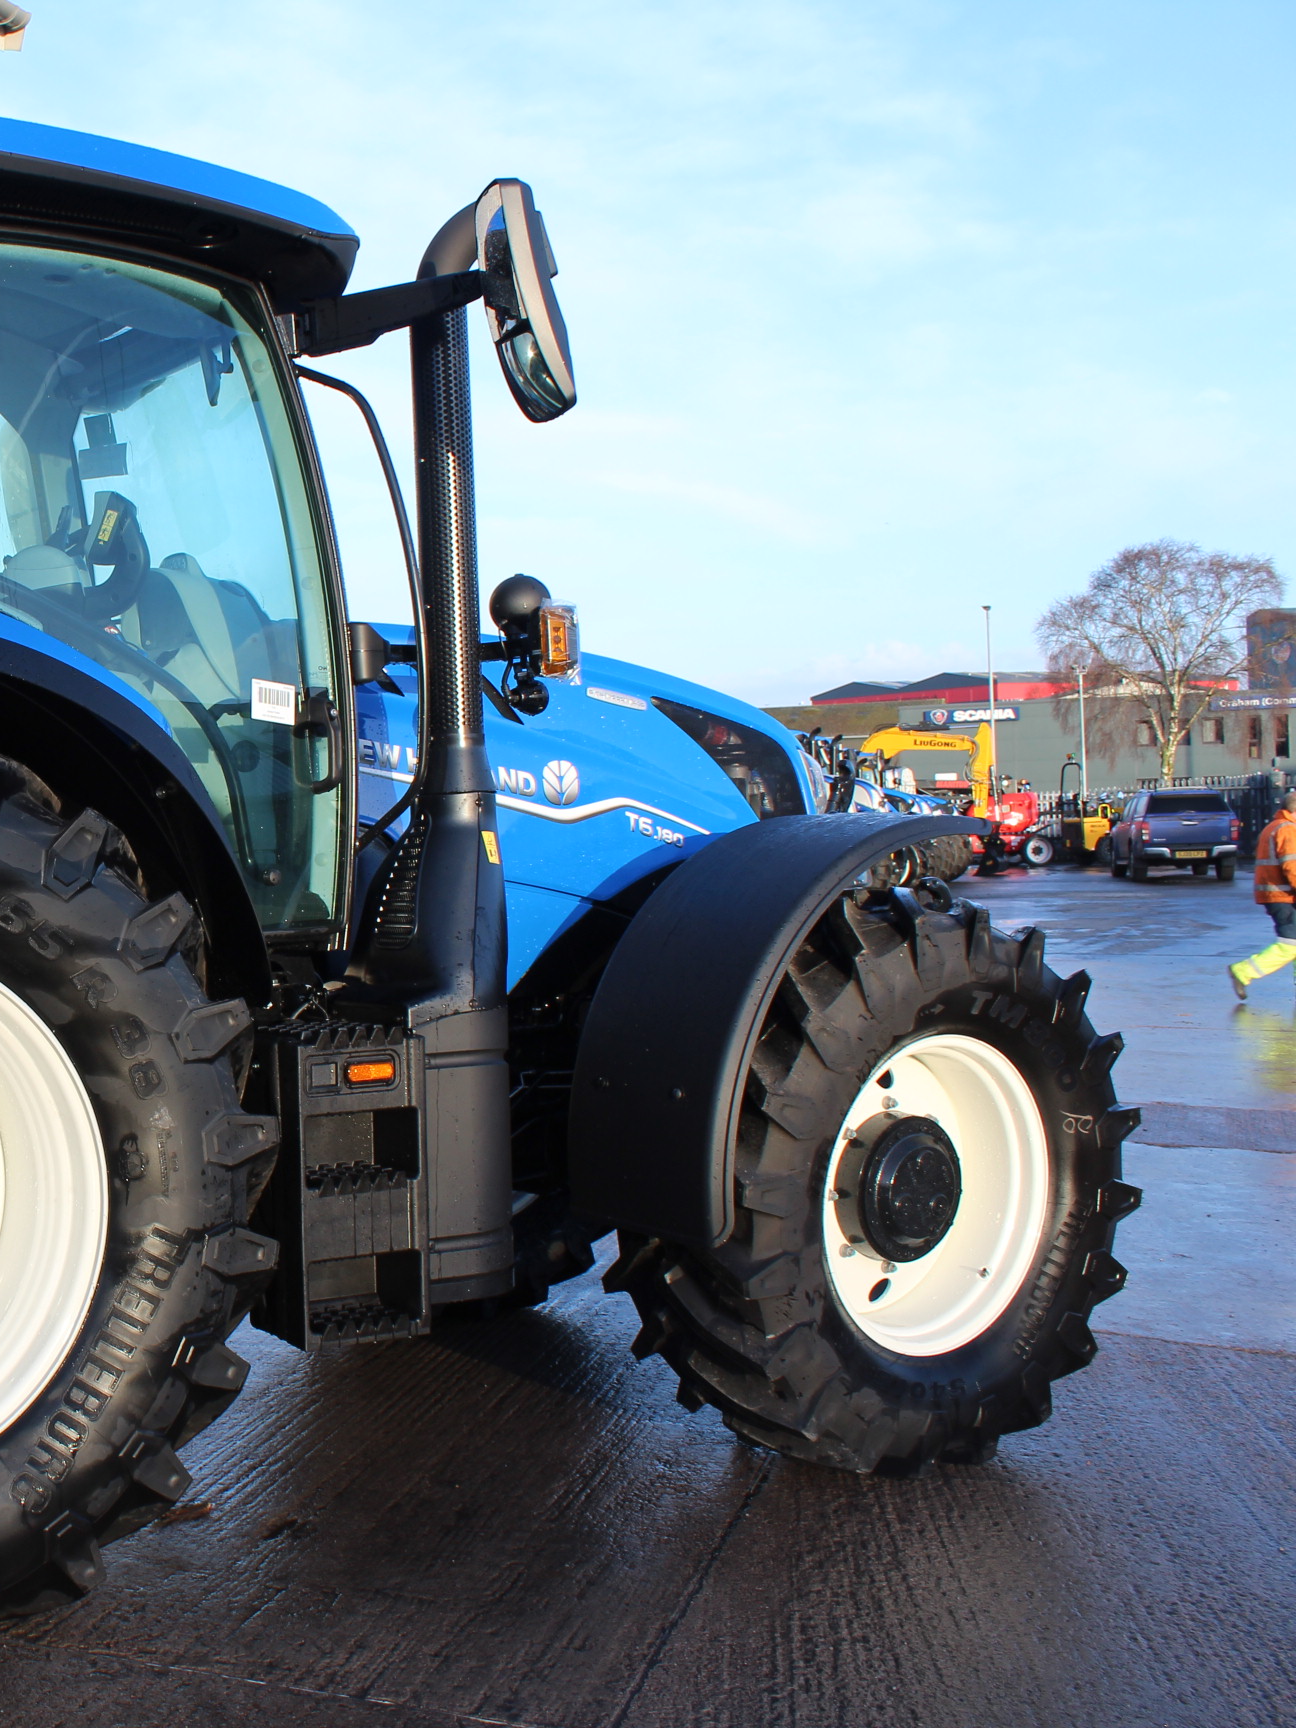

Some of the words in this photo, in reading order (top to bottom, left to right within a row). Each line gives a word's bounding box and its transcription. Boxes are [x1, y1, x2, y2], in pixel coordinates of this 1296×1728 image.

[358, 738, 402, 770] EW
[625, 810, 685, 848] T6.180
[1011, 1198, 1095, 1361] TRELLEBORG
[8, 1222, 195, 1514] TRELLEBORG
